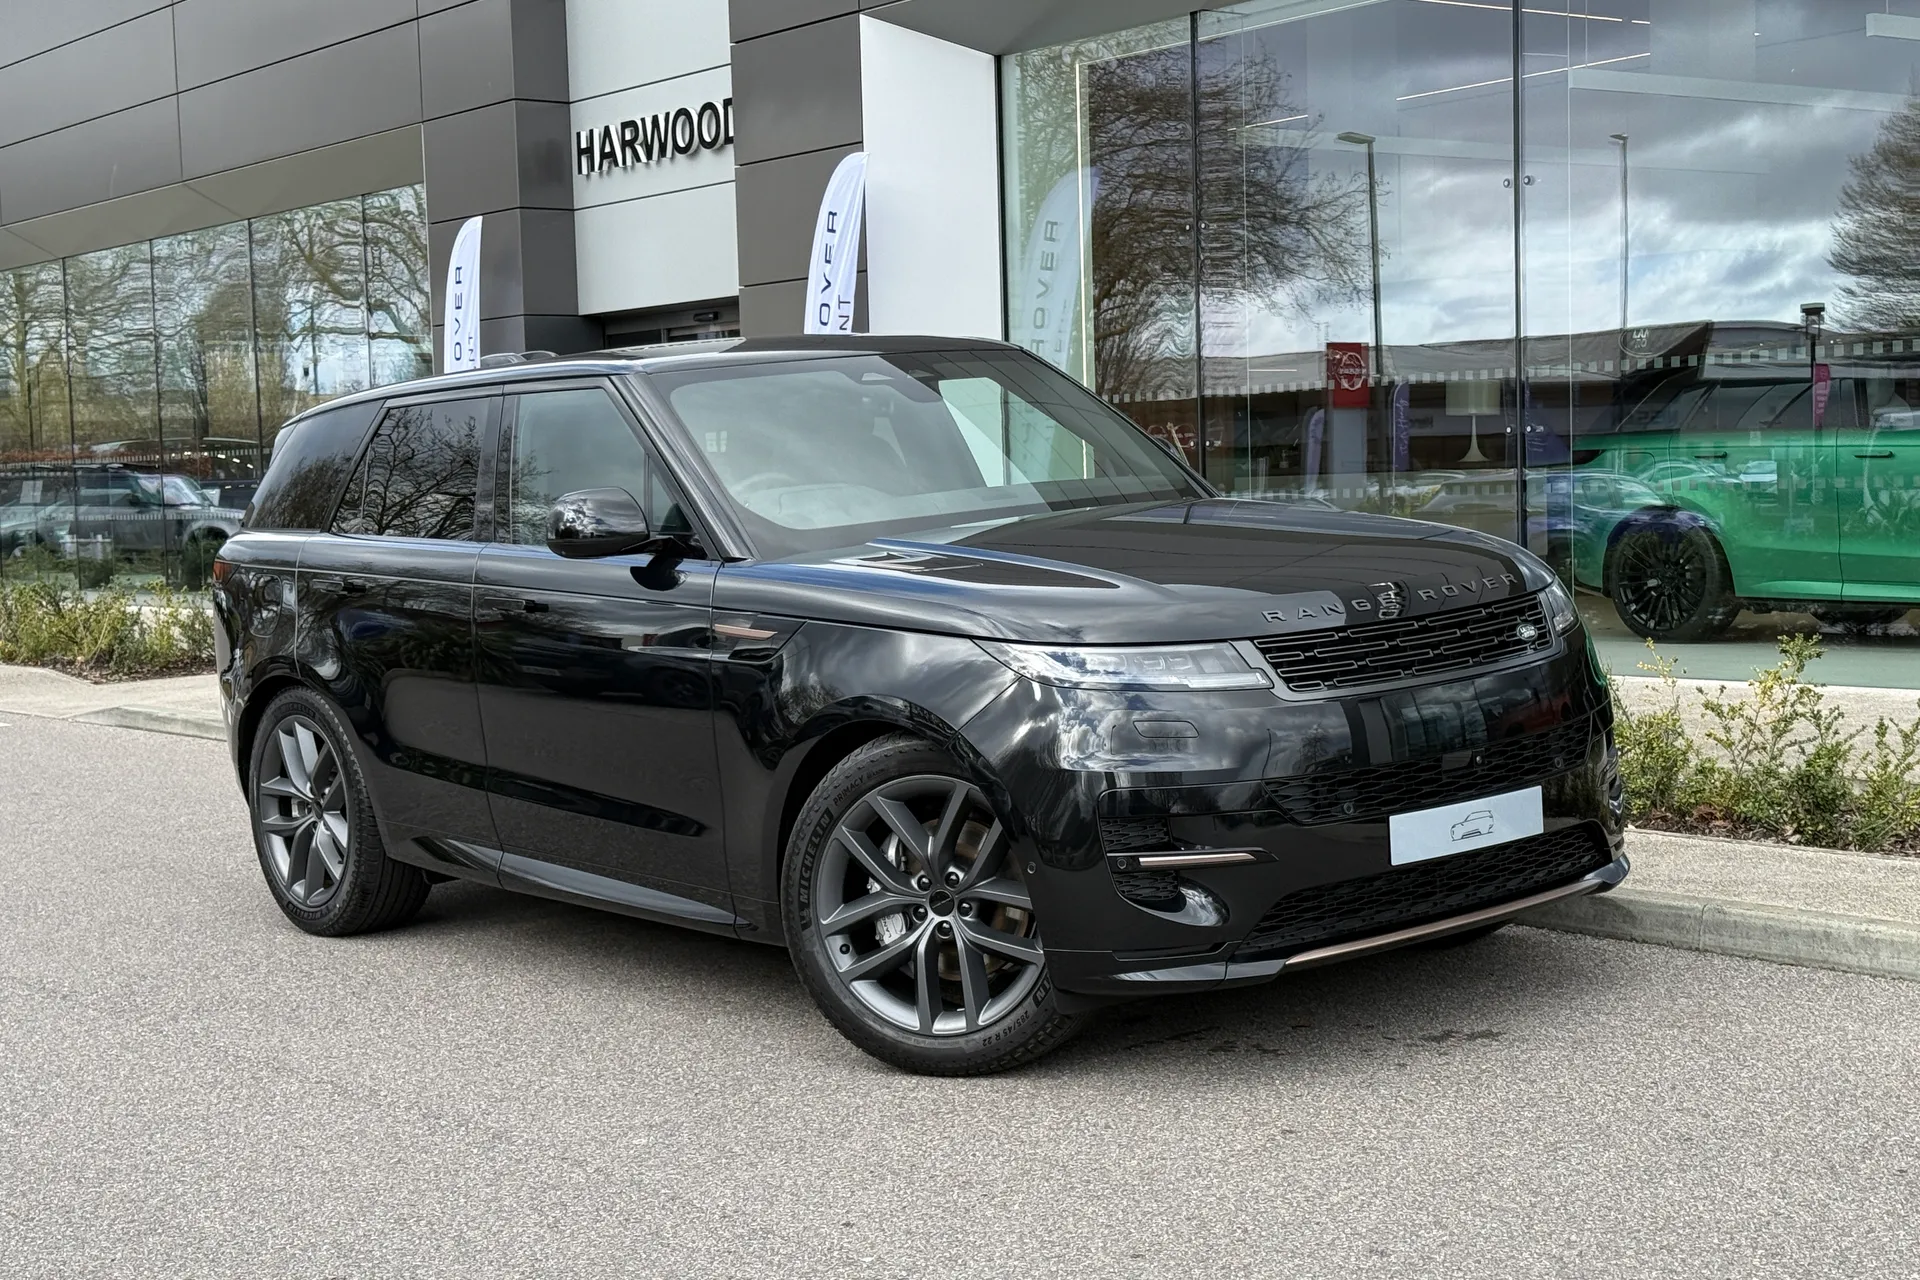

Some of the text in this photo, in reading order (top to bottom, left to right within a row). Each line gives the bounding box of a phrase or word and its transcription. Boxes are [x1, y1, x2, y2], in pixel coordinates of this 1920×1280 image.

[468, 332, 477, 369] NT
[1261, 573, 1518, 623] RANGE ROVER
[833, 775, 864, 806] PRIMACY
[799, 813, 831, 904] MICHELIN
[1003, 1010, 1030, 1037] 285/45
[982, 1036, 993, 1047] 22
